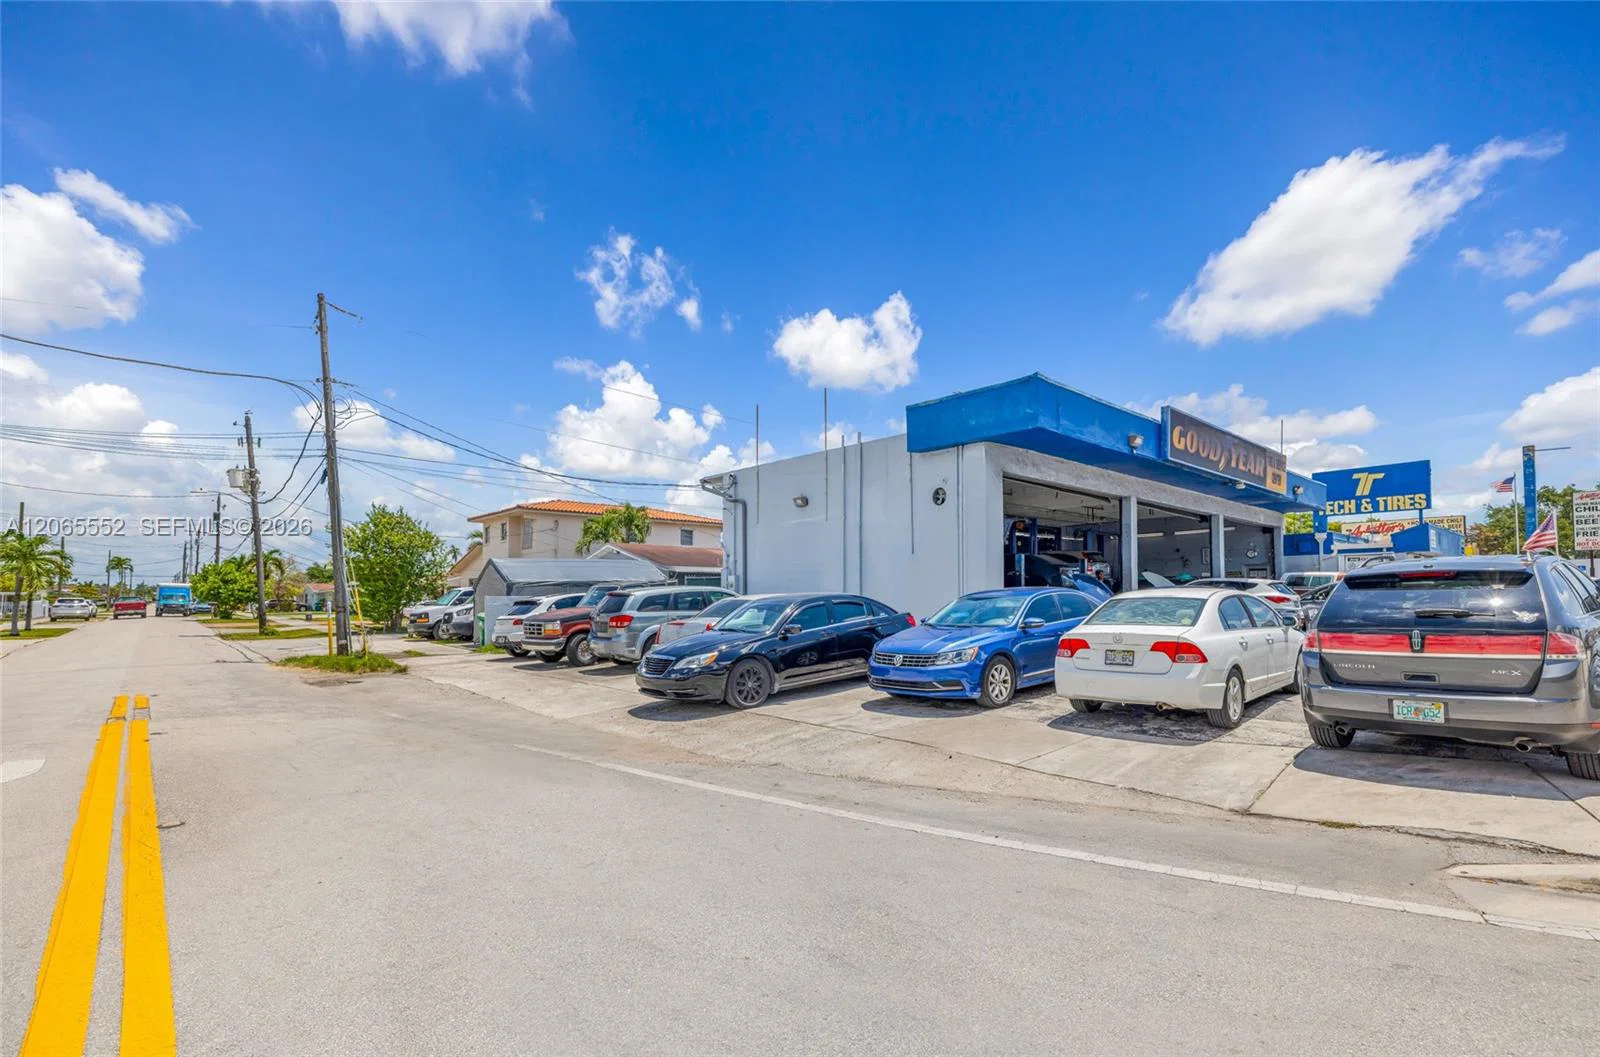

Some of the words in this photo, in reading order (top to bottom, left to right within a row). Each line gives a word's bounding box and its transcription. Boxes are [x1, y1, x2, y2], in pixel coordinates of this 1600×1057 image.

[1172, 425, 1265, 477] GOODYEAR
[1319, 499, 1356, 515] ECH
[1360, 498, 1373, 512] &
[1376, 493, 1427, 511] TIRES
